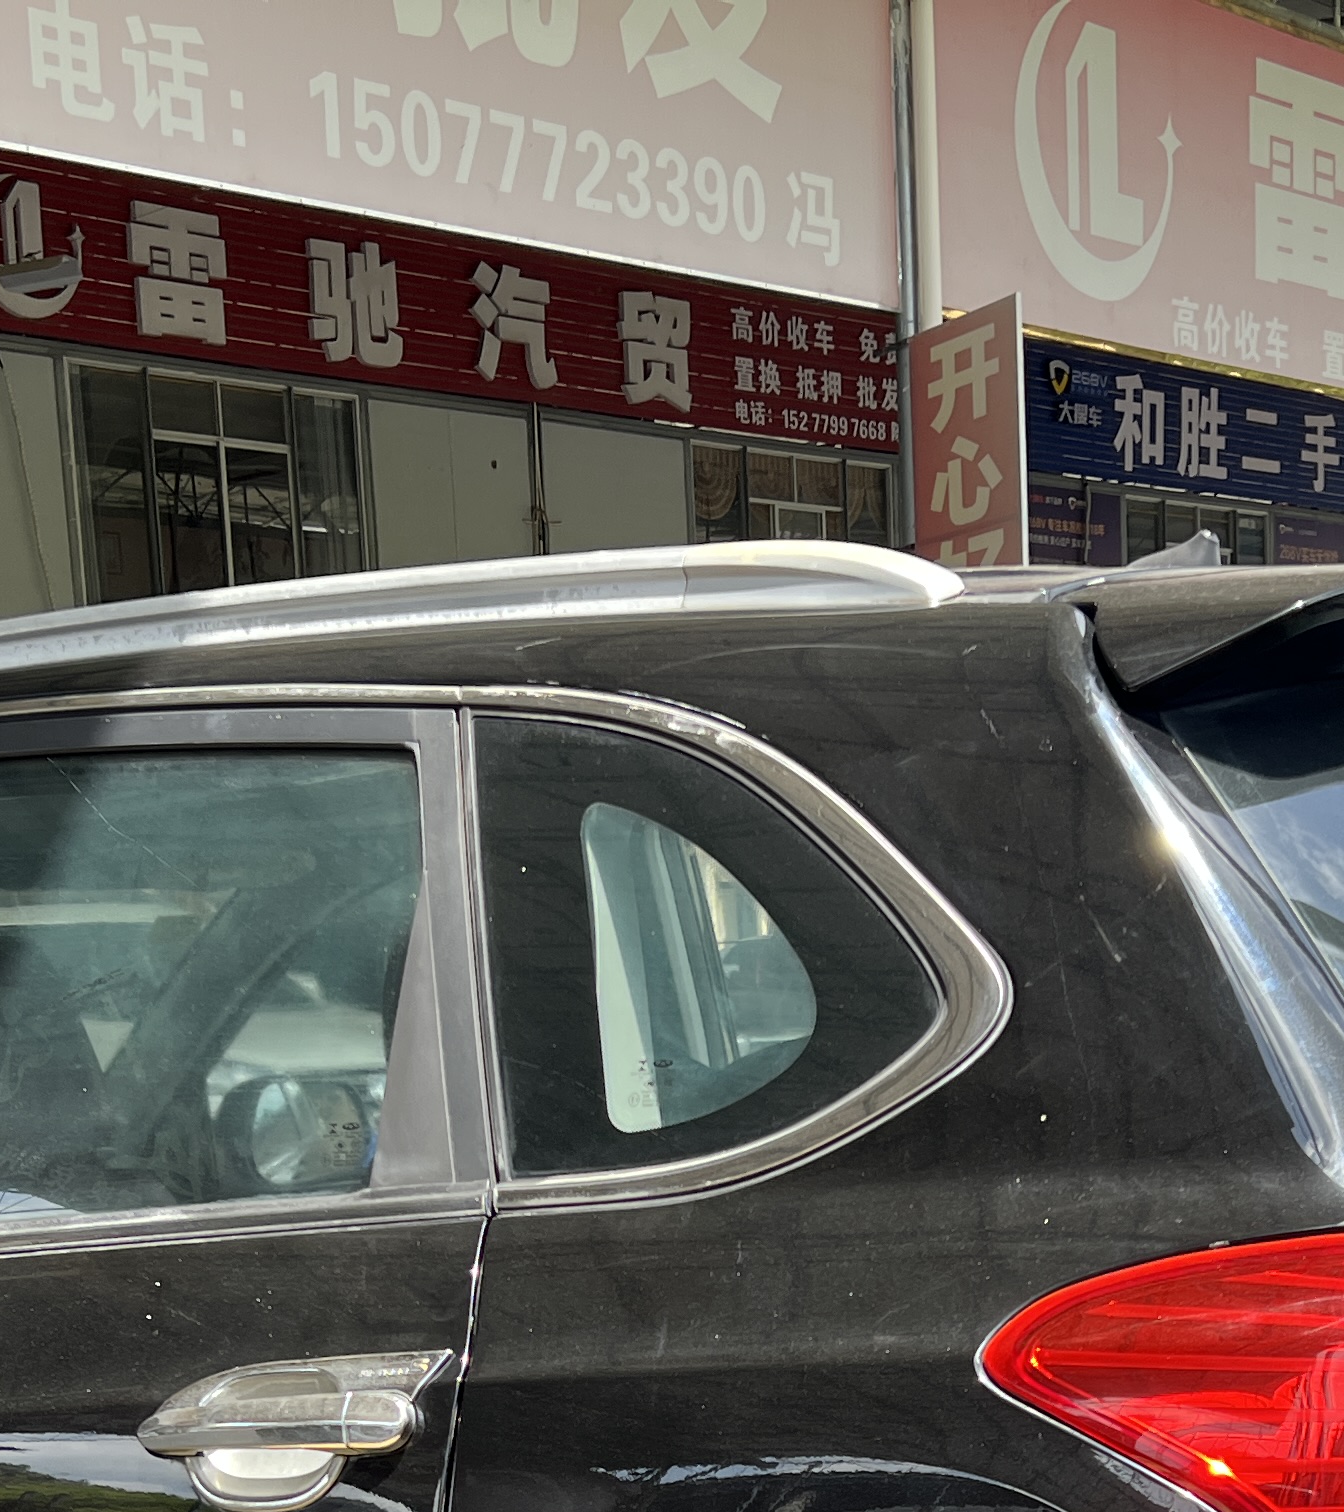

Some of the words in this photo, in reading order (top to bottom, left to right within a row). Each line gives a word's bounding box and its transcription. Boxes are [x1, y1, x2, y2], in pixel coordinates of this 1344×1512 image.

[309, 70, 766, 243] 15077723390
[786, 170, 841, 267] 冯
[127, 199, 694, 415] 雷驰汽贸
[729, 306, 835, 356] 高价收车
[1172, 296, 1289, 370] 高价收车
[733, 355, 782, 396] 置换
[795, 364, 843, 405] 抵押
